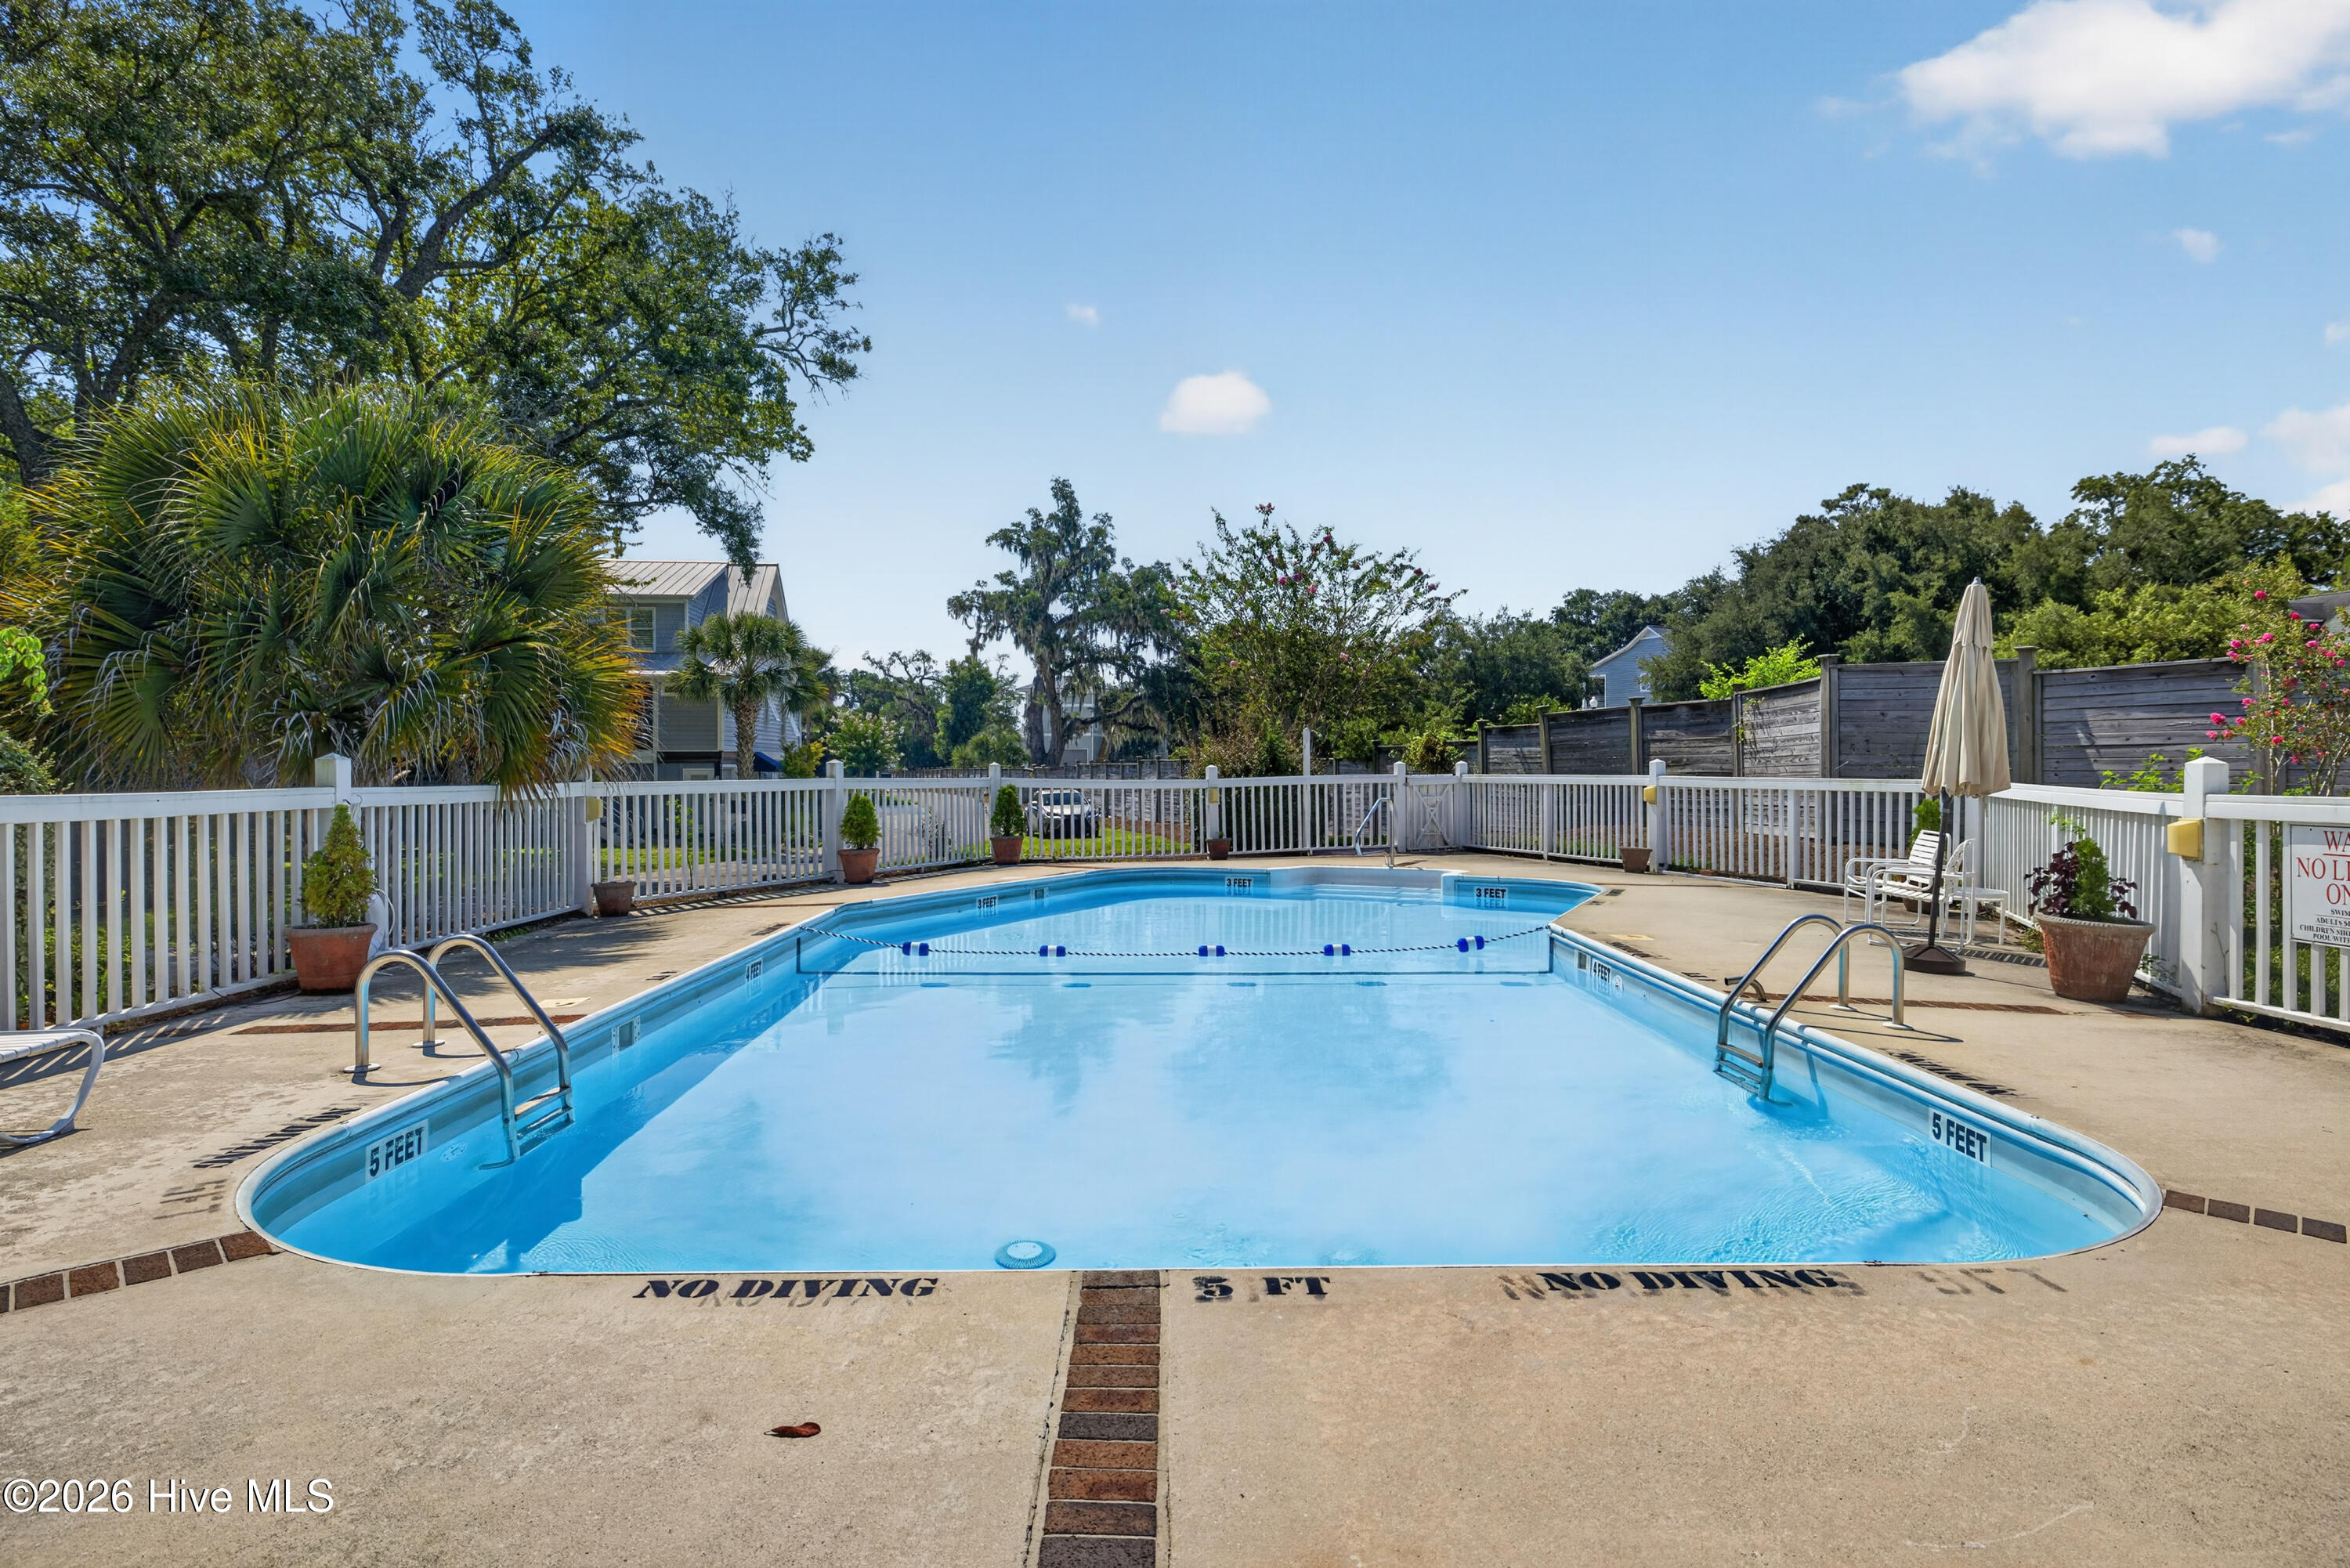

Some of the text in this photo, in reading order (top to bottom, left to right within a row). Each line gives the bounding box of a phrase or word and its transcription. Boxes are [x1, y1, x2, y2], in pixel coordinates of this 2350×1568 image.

[2296, 857, 2326, 880] NO
[1226, 878, 1253, 887] 3 FEET
[1476, 887, 1506, 899] 3 FEET
[977, 895, 997, 909] 3 FEET
[2299, 924, 2335, 934] CHILDREN
[1593, 961, 1611, 983] 4 FEET
[1932, 1111, 1987, 1163] 5 FEET
[369, 1127, 425, 1177] 5 FEET
[632, 1277, 938, 1299] NO DIVING
[1194, 1276, 1331, 1299] 5 FT
[1537, 1269, 1840, 1292] NO DIVING
